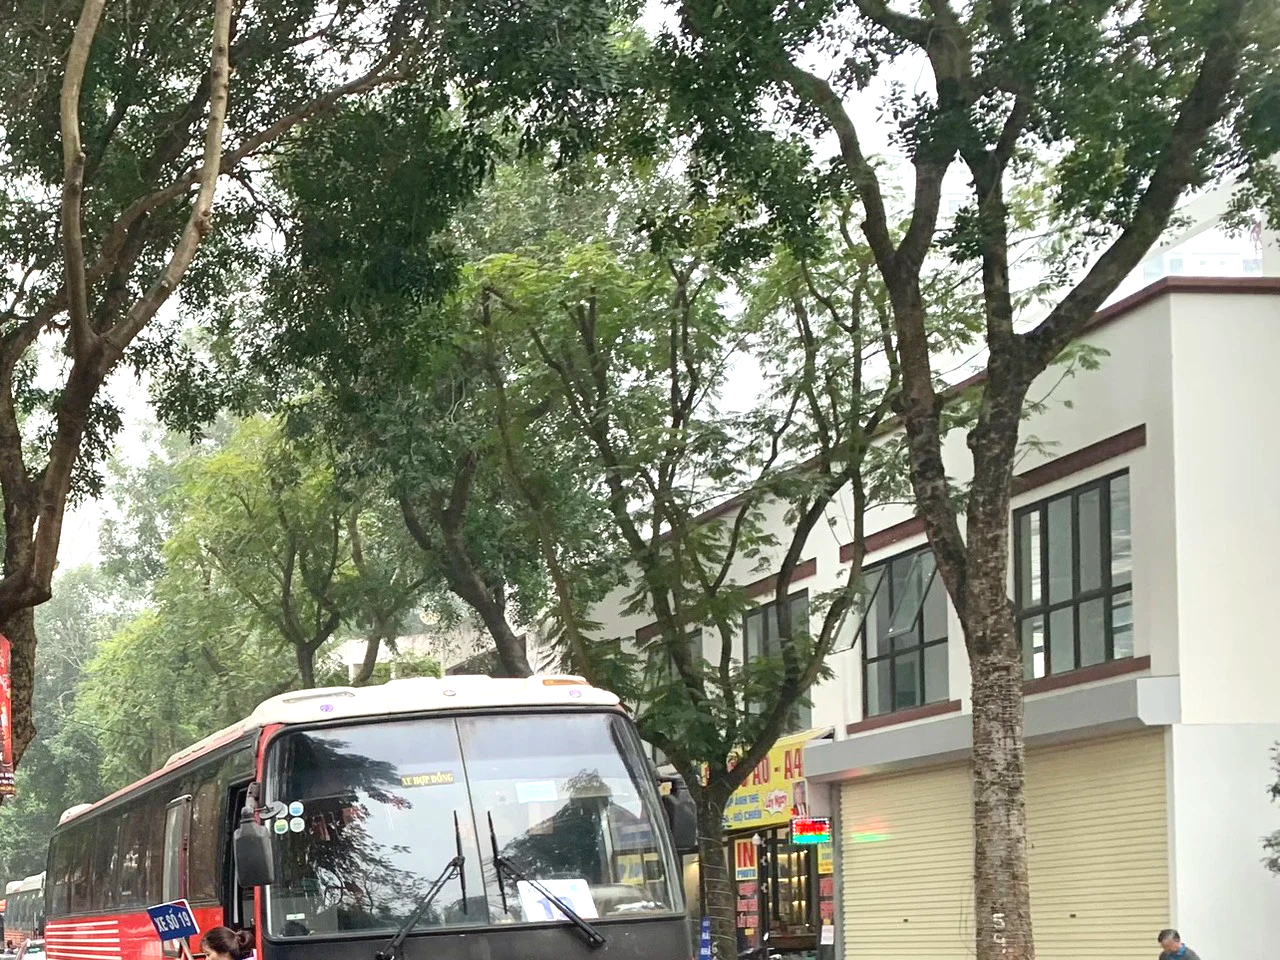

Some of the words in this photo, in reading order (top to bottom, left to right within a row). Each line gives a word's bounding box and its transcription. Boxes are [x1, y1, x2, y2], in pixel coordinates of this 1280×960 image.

[784, 748, 803, 780] A4
[737, 842, 755, 868] IN
[153, 916, 169, 932] XE
[166, 908, 180, 930] SỐ
[178, 911, 191, 928] 19
